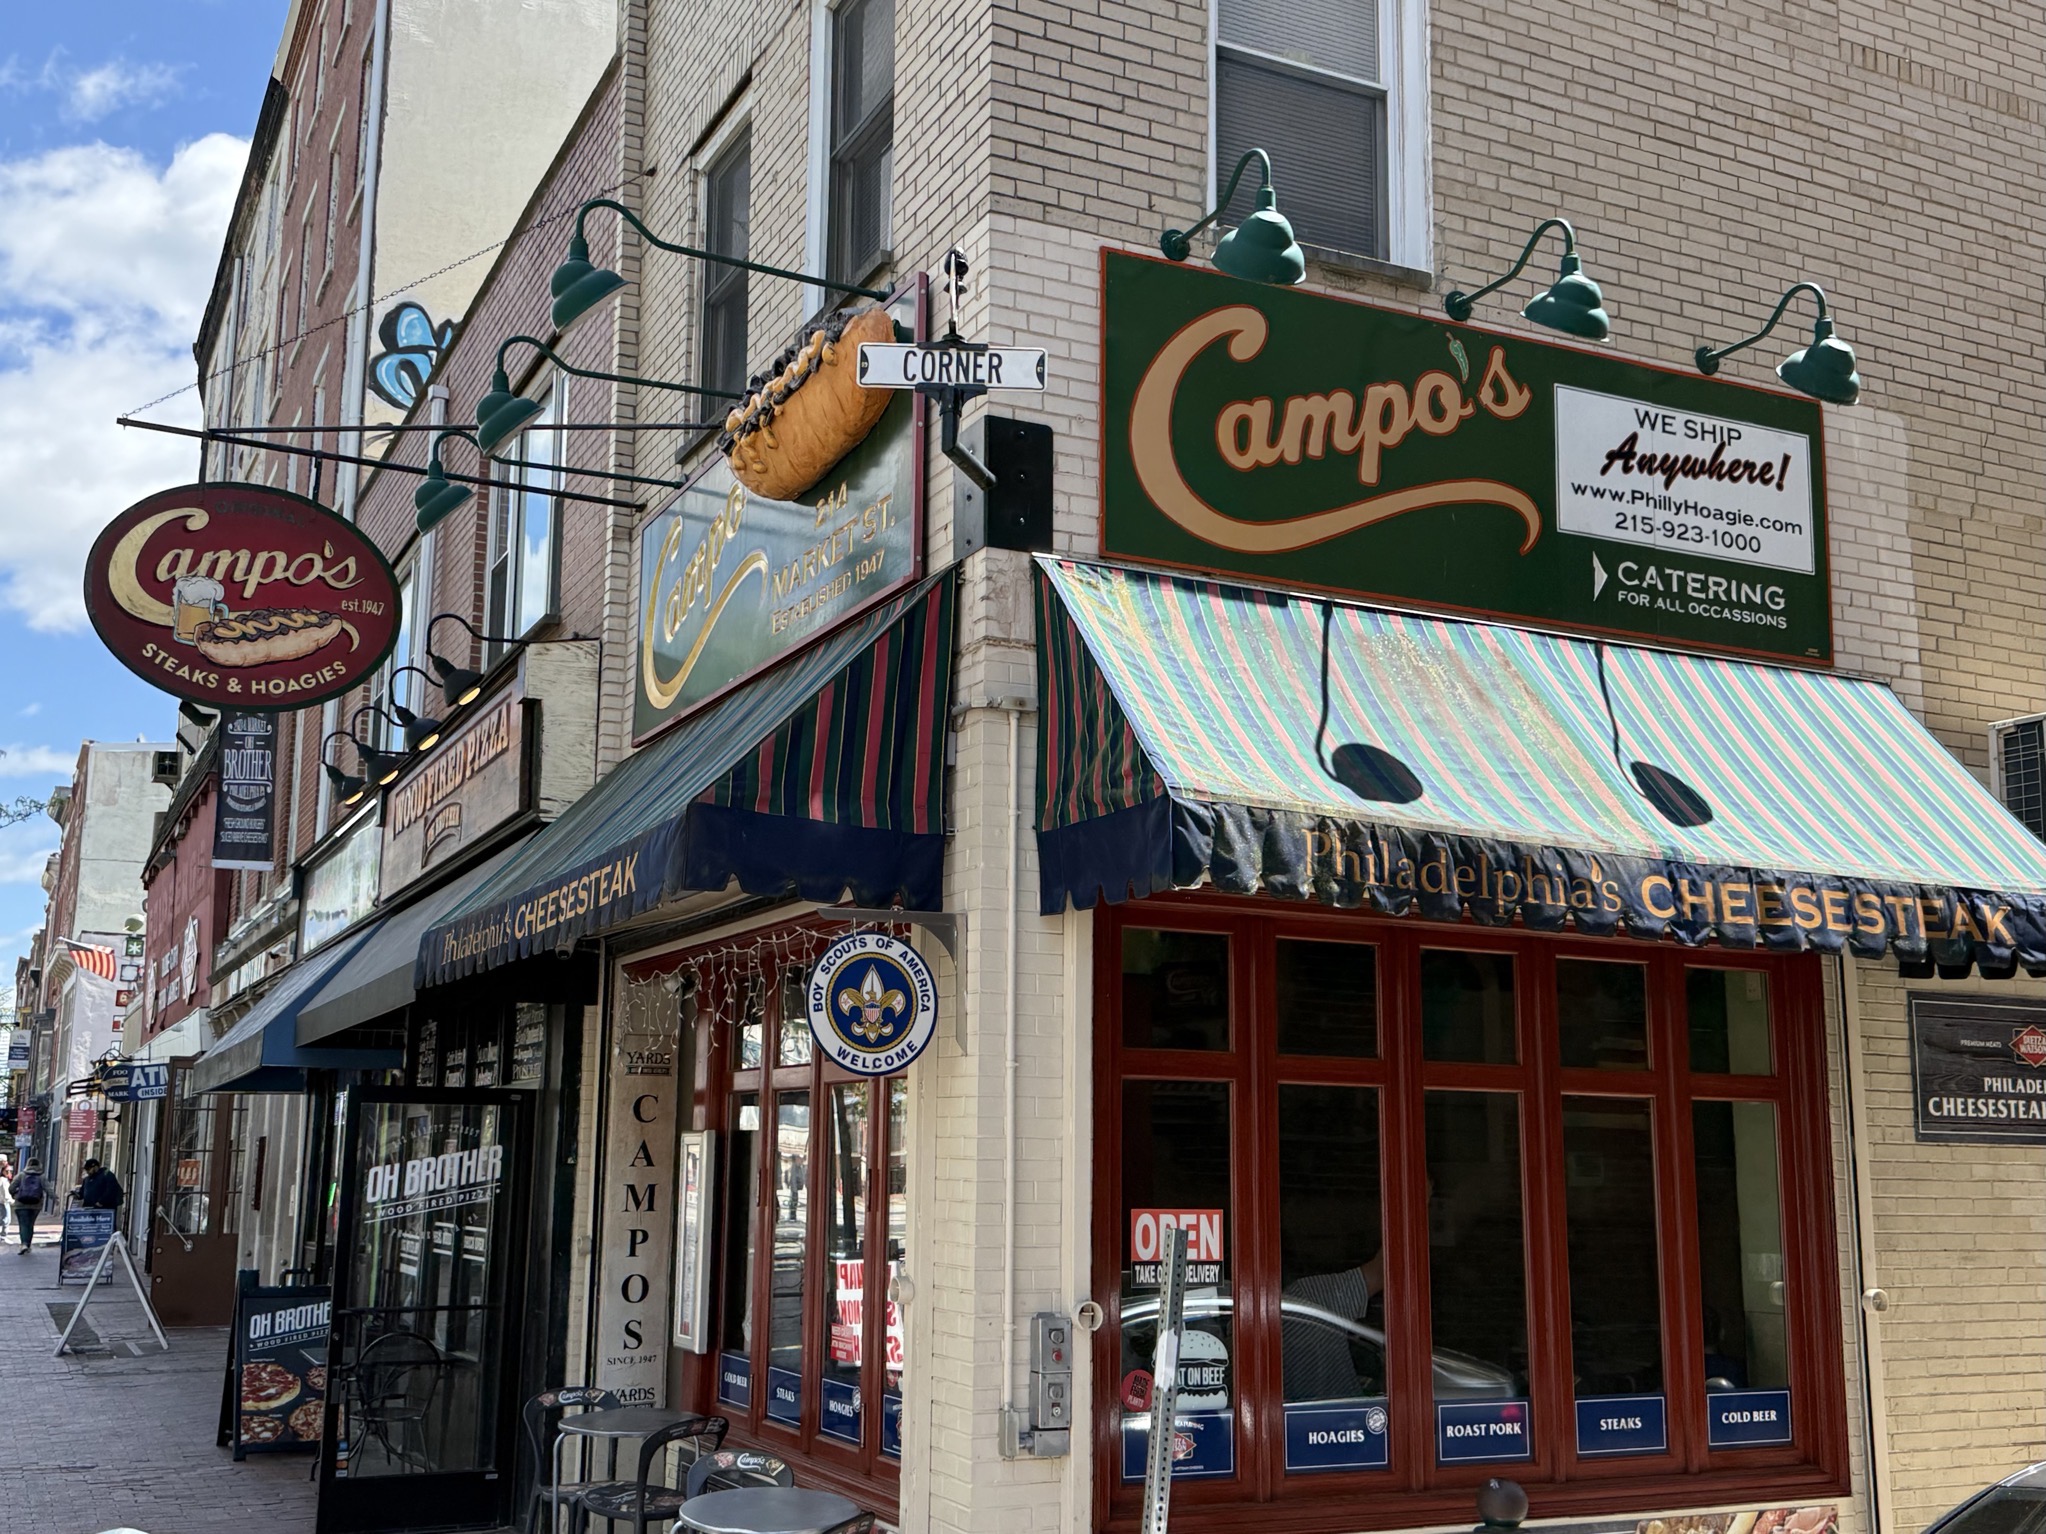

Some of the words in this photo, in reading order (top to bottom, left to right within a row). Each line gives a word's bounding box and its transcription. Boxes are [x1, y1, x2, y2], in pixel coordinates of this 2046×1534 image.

[903, 350, 1003, 384] CORNER
[1129, 304, 1542, 555] Campo's
[1634, 408, 1677, 435] WE
[1684, 419, 1742, 447] SHIP
[1600, 431, 1791, 491] Anywhere!
[815, 481, 847, 528] 214
[1571, 482, 1802, 535] www.PhillyHoagie.com
[772, 519, 858, 603] MARKET
[862, 492, 896, 544] ST.
[1615, 512, 1761, 553] 215-923-1000
[108, 507, 365, 653] Campo's
[772, 571, 851, 636] ESTABLISHED
[855, 549, 885, 585] 1947
[1618, 561, 1786, 611] CATERING
[341, 599, 385, 616] est.1947
[1618, 591, 1650, 608] FOR
[1654, 597, 1685, 614] ALL
[1688, 602, 1788, 629] OCCASSIONS
[142, 643, 219, 689] STEAKS
[227, 677, 242, 693] &
[251, 660, 347, 695] HOAGIES
[465, 703, 509, 779] PIZZA
[223, 749, 272, 780] BROTHER
[514, 851, 639, 940] CHEESESTEAK
[1302, 828, 1622, 920] Philadelphia's
[1642, 874, 2016, 946] CHEESESTEAK
[813, 982, 825, 1013] BOY
[820, 937, 868, 975] SCOUTS
[876, 938, 894, 951] OF
[899, 950, 931, 1013] AMERICA
[627, 1051, 671, 1065] YARDS
[837, 1040, 918, 1070] WELCOME
[366, 1163, 400, 1203] OH
[404, 1145, 503, 1196] BROTHER
[377, 1203, 413, 1217] WOOD
[418, 1196, 453, 1209] FIRED
[458, 1187, 493, 1202] PIZZA
[1135, 1213, 1219, 1260] OPEN
[1135, 1265, 1156, 1283] TAKE
[249, 1314, 272, 1339] OH
[274, 1302, 331, 1334] BROTHE
[257, 1338, 281, 1348] WOOD
[607, 1356, 635, 1365] SINCE
[724, 1372, 737, 1385] COLD
[1187, 1367, 1201, 1386] ON
[1202, 1367, 1225, 1385] BEEF
[776, 1388, 795, 1403] STEAKS
[829, 1400, 853, 1417] HOAGIES
[1446, 1423, 1487, 1438] ROAST
[1489, 1421, 1523, 1436] PORK
[1600, 1417, 1642, 1431] STEAKS
[1722, 1411, 1750, 1424] COLD
[1752, 1409, 1778, 1422] BEER
[1308, 1430, 1365, 1445] HOAGIES
